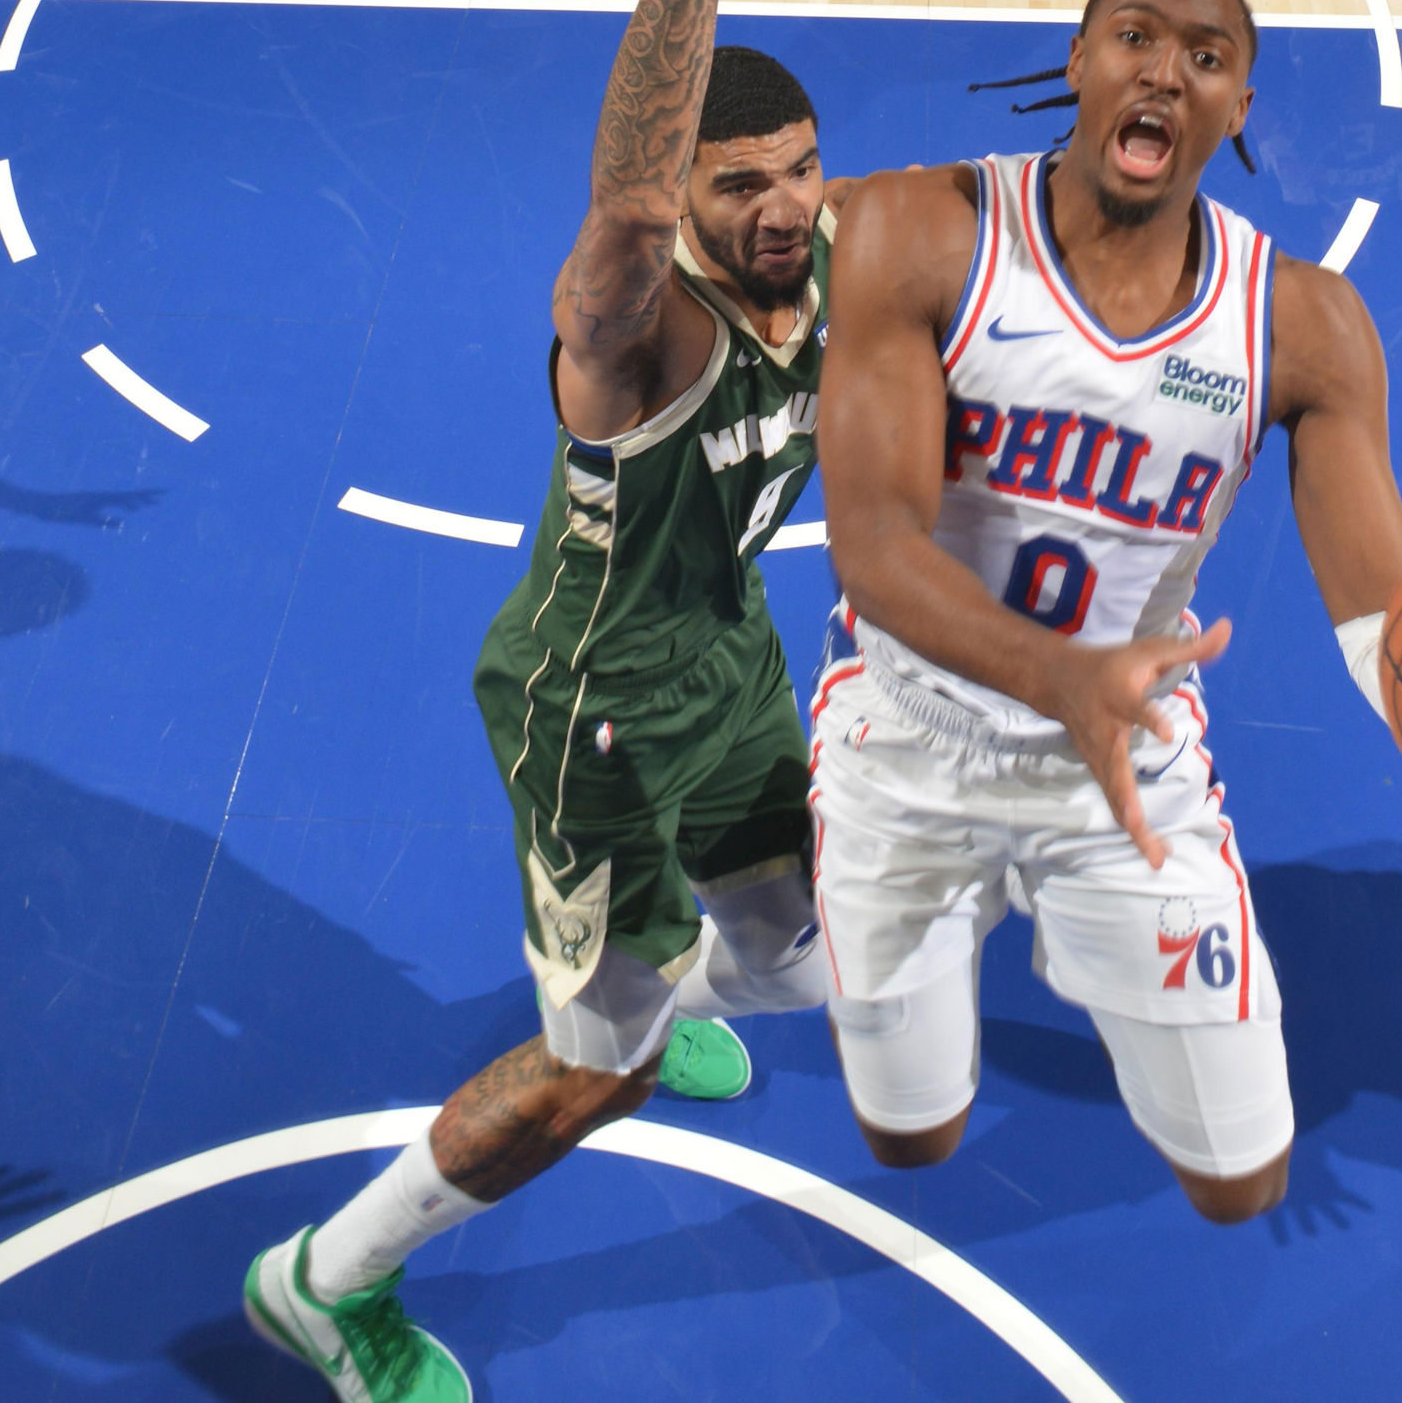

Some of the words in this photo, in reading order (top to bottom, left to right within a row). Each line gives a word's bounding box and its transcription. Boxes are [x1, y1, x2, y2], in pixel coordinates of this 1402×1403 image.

[1159, 380, 1243, 417] energy
[1163, 353, 1248, 396] Bloom
[942, 396, 1225, 535] PHILA
[1003, 532, 1099, 637] 0
[1157, 921, 1236, 992] 76
